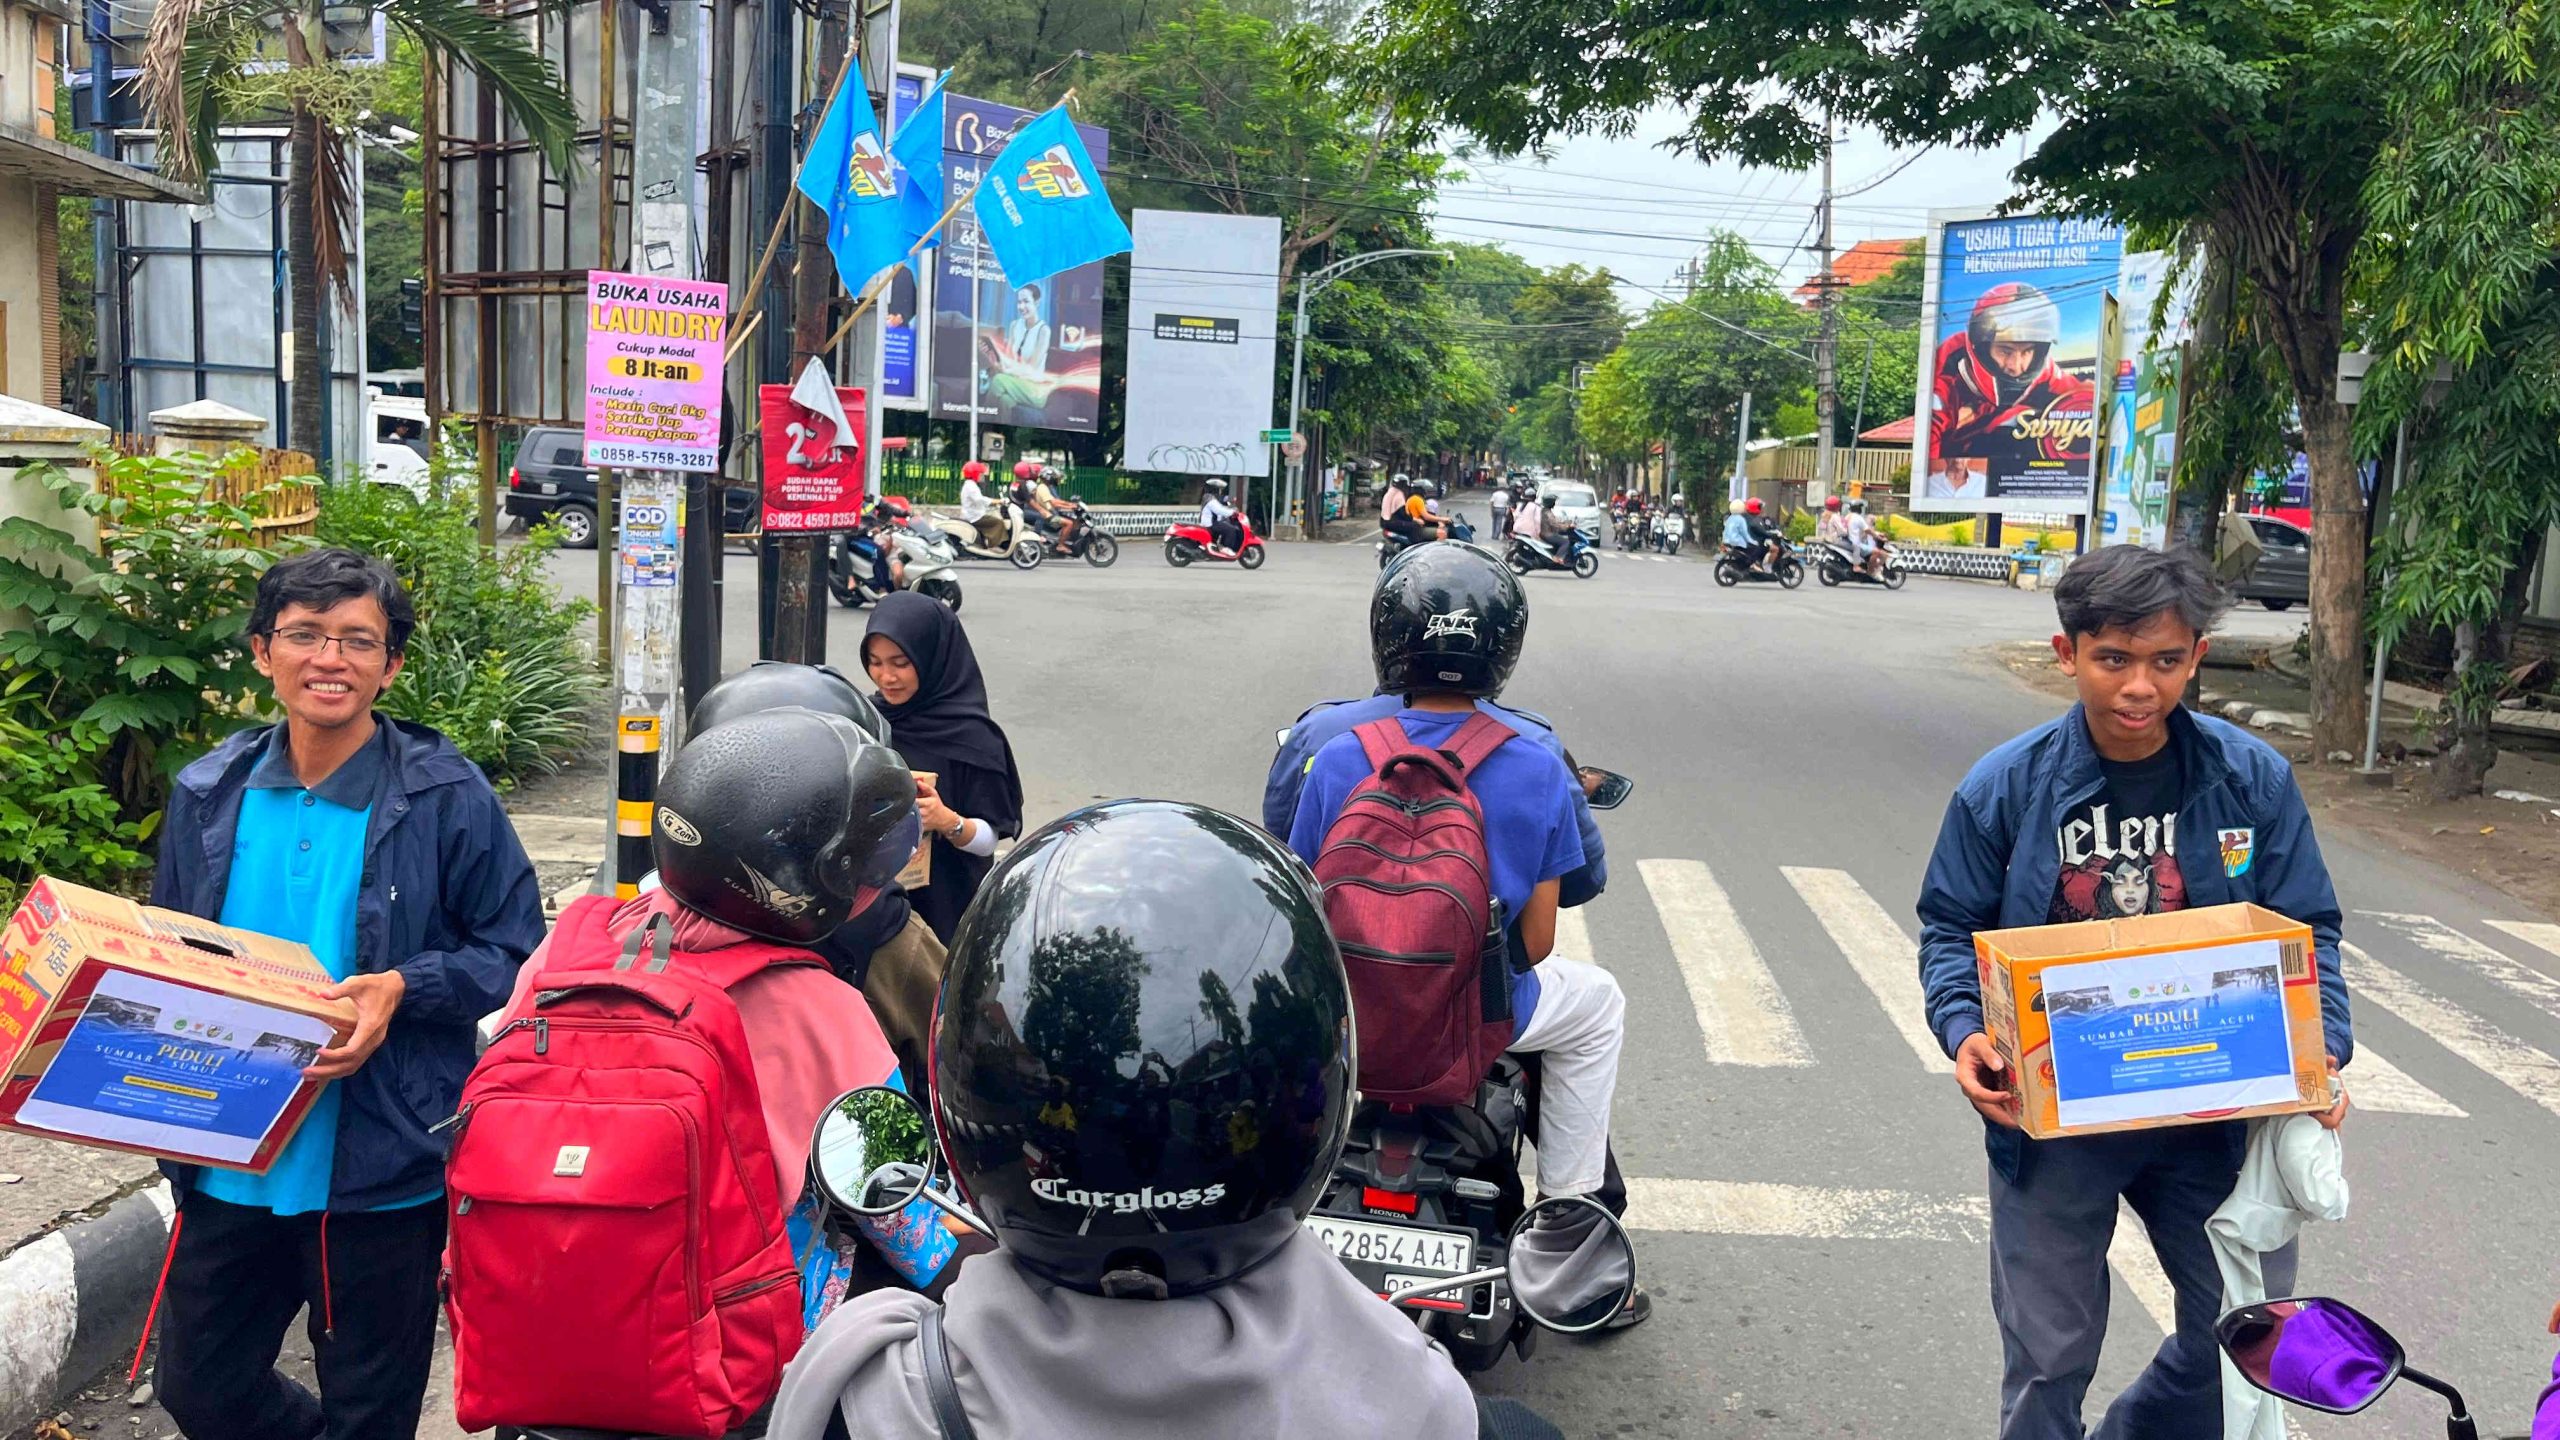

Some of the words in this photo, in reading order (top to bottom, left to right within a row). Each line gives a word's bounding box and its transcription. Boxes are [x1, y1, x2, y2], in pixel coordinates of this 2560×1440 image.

[2015, 221, 2056, 248] TIDAK
[1963, 250, 2050, 274] MENGKHIANATI
[597, 283, 649, 302] BUKA
[657, 289, 721, 310] USAHA
[591, 304, 725, 342] LAUNDRY
[617, 341, 655, 357] Cukup
[659, 346, 696, 358] Modal
[625, 358, 637, 376] 8
[642, 360, 689, 381] Jt-an
[590, 384, 635, 397] Include
[605, 399, 644, 413] Mesin
[648, 402, 678, 415] Cuci
[605, 411, 654, 426] Setrika
[657, 415, 684, 428] Uap
[2012, 409, 2094, 452] Surya
[605, 424, 699, 442] Perlengkapan
[601, 447, 714, 468] 0858-5758-3287
[786, 476, 812, 485] SUDAH
[813, 477, 839, 486] DAPAT
[824, 486, 844, 495] PLUS
[625, 507, 667, 525] COD
[778, 512, 803, 528] 0822
[804, 512, 831, 528] 4593
[1441, 672, 1460, 680] DOT
[663, 815, 674, 828] G
[674, 825, 698, 843] Zone
[45, 928, 72, 959] HYPE
[44, 950, 68, 978] ABIS
[2079, 1028, 2135, 1043] SUMBAR
[2153, 1022, 2200, 1035] SUMUT
[2219, 1013, 2255, 1026] ACEH
[2133, 1008, 2199, 1028] PEDULI
[95, 1044, 154, 1063] SUMBAR
[172, 1060, 218, 1077] SUMUT
[234, 1072, 270, 1087] ACEH
[156, 1042, 227, 1069] PEDULI
[1030, 1177, 1227, 1214] Cargloss
[1369, 1208, 1409, 1221] HONDA
[1338, 1229, 1404, 1264] 2854
[1412, 1239, 1466, 1270] AAT
